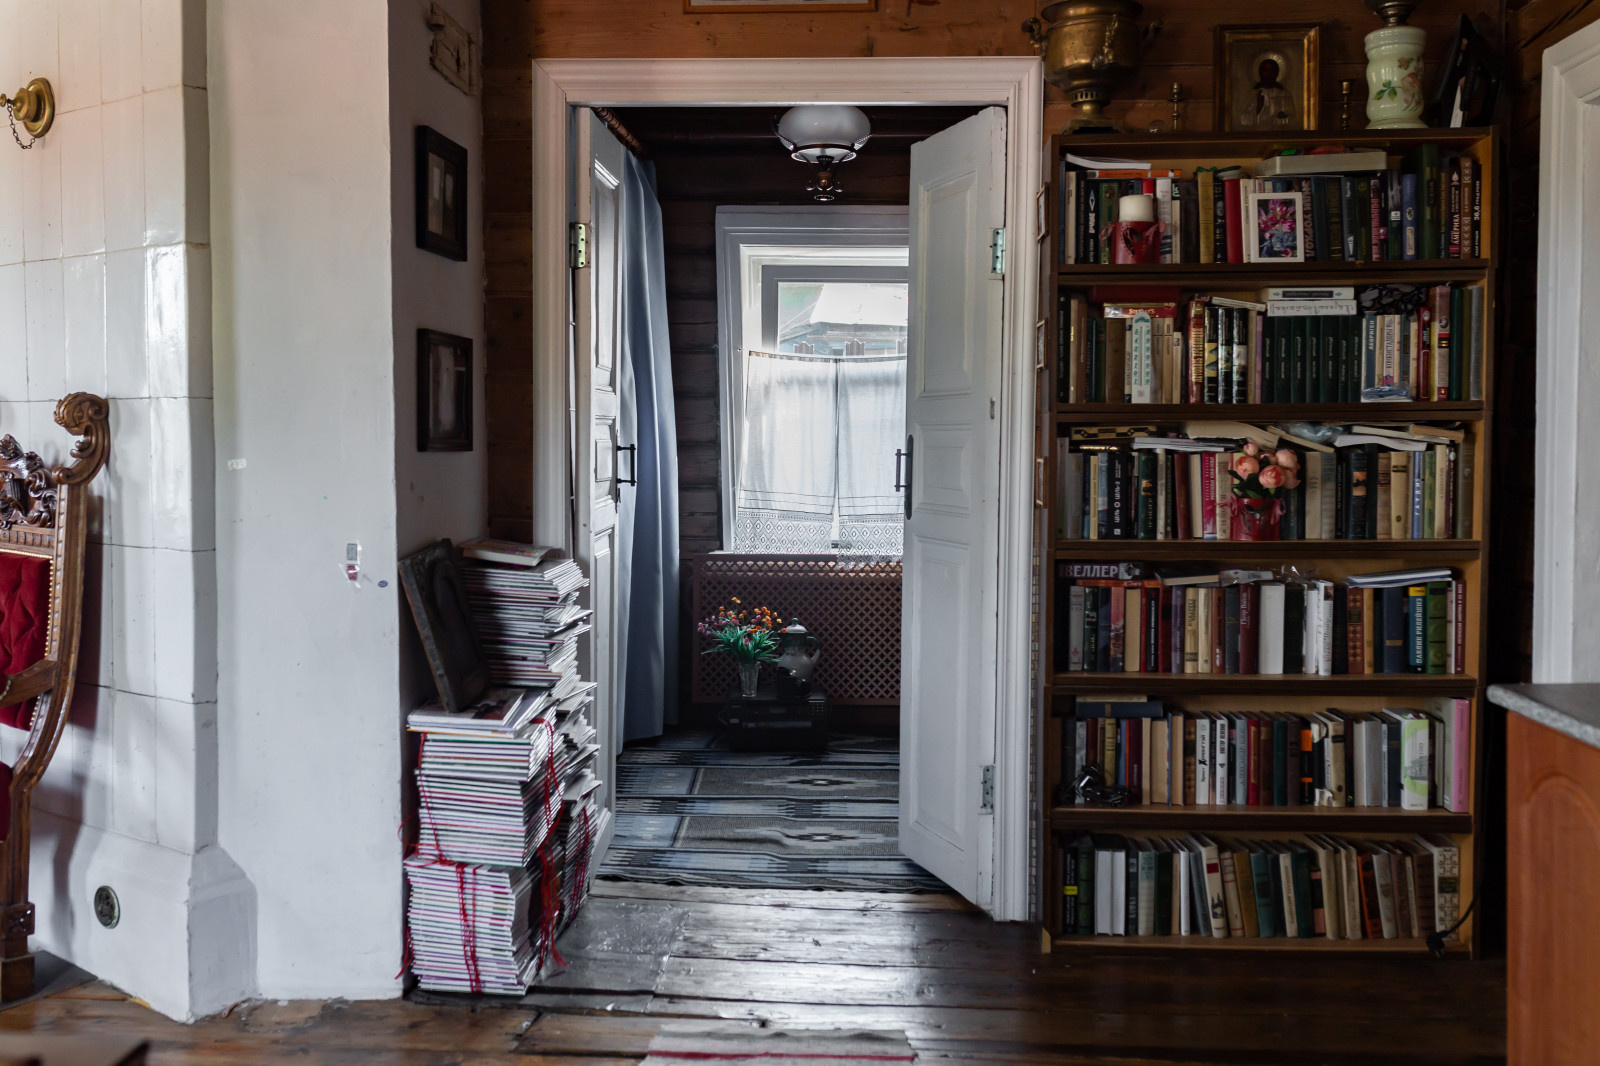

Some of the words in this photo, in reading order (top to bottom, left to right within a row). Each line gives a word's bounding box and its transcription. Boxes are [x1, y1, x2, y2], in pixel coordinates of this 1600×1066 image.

[1473, 205, 1481, 221] 36,6
[1452, 214, 1460, 245] АМЕРИКА
[1064, 565, 1118, 578] ВЕЛЛЕР
[1414, 598, 1423, 634] РИЛЕЙШНЗ
